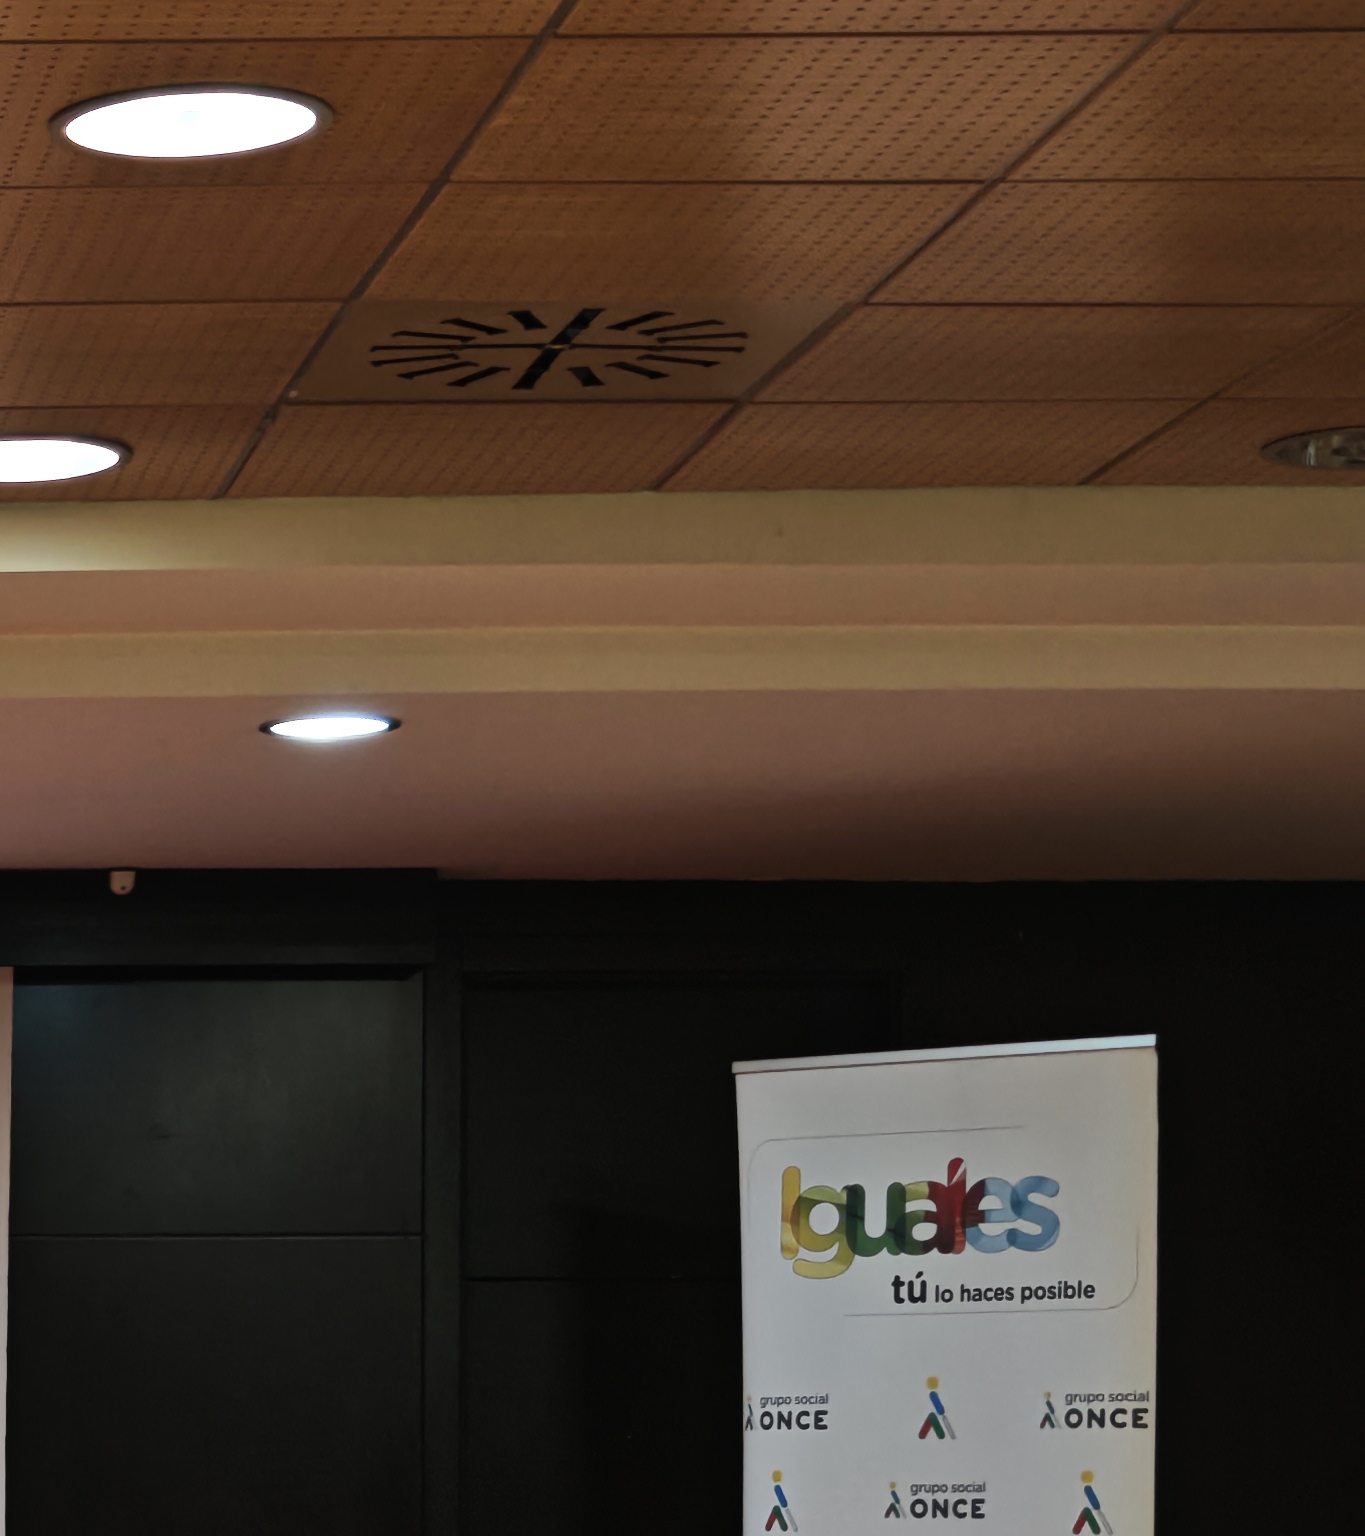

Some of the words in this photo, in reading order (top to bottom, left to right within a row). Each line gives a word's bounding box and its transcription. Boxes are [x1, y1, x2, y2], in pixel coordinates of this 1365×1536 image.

[780, 1157, 1060, 1279] Iguales
[891, 1271, 927, 1304] tú
[935, 1285, 953, 1303] lo
[960, 1284, 1014, 1302] haces
[1021, 1280, 1095, 1304] posible
[760, 1395, 792, 1408] grupo
[795, 1392, 828, 1404] social
[1065, 1393, 1104, 1405] grupo
[1108, 1390, 1149, 1402] social
[760, 1410, 828, 1430] ONCE
[1065, 1408, 1148, 1429] ONCE
[910, 1483, 948, 1496] grupo
[951, 1481, 986, 1493] social
[910, 1498, 985, 1519] ONCE
